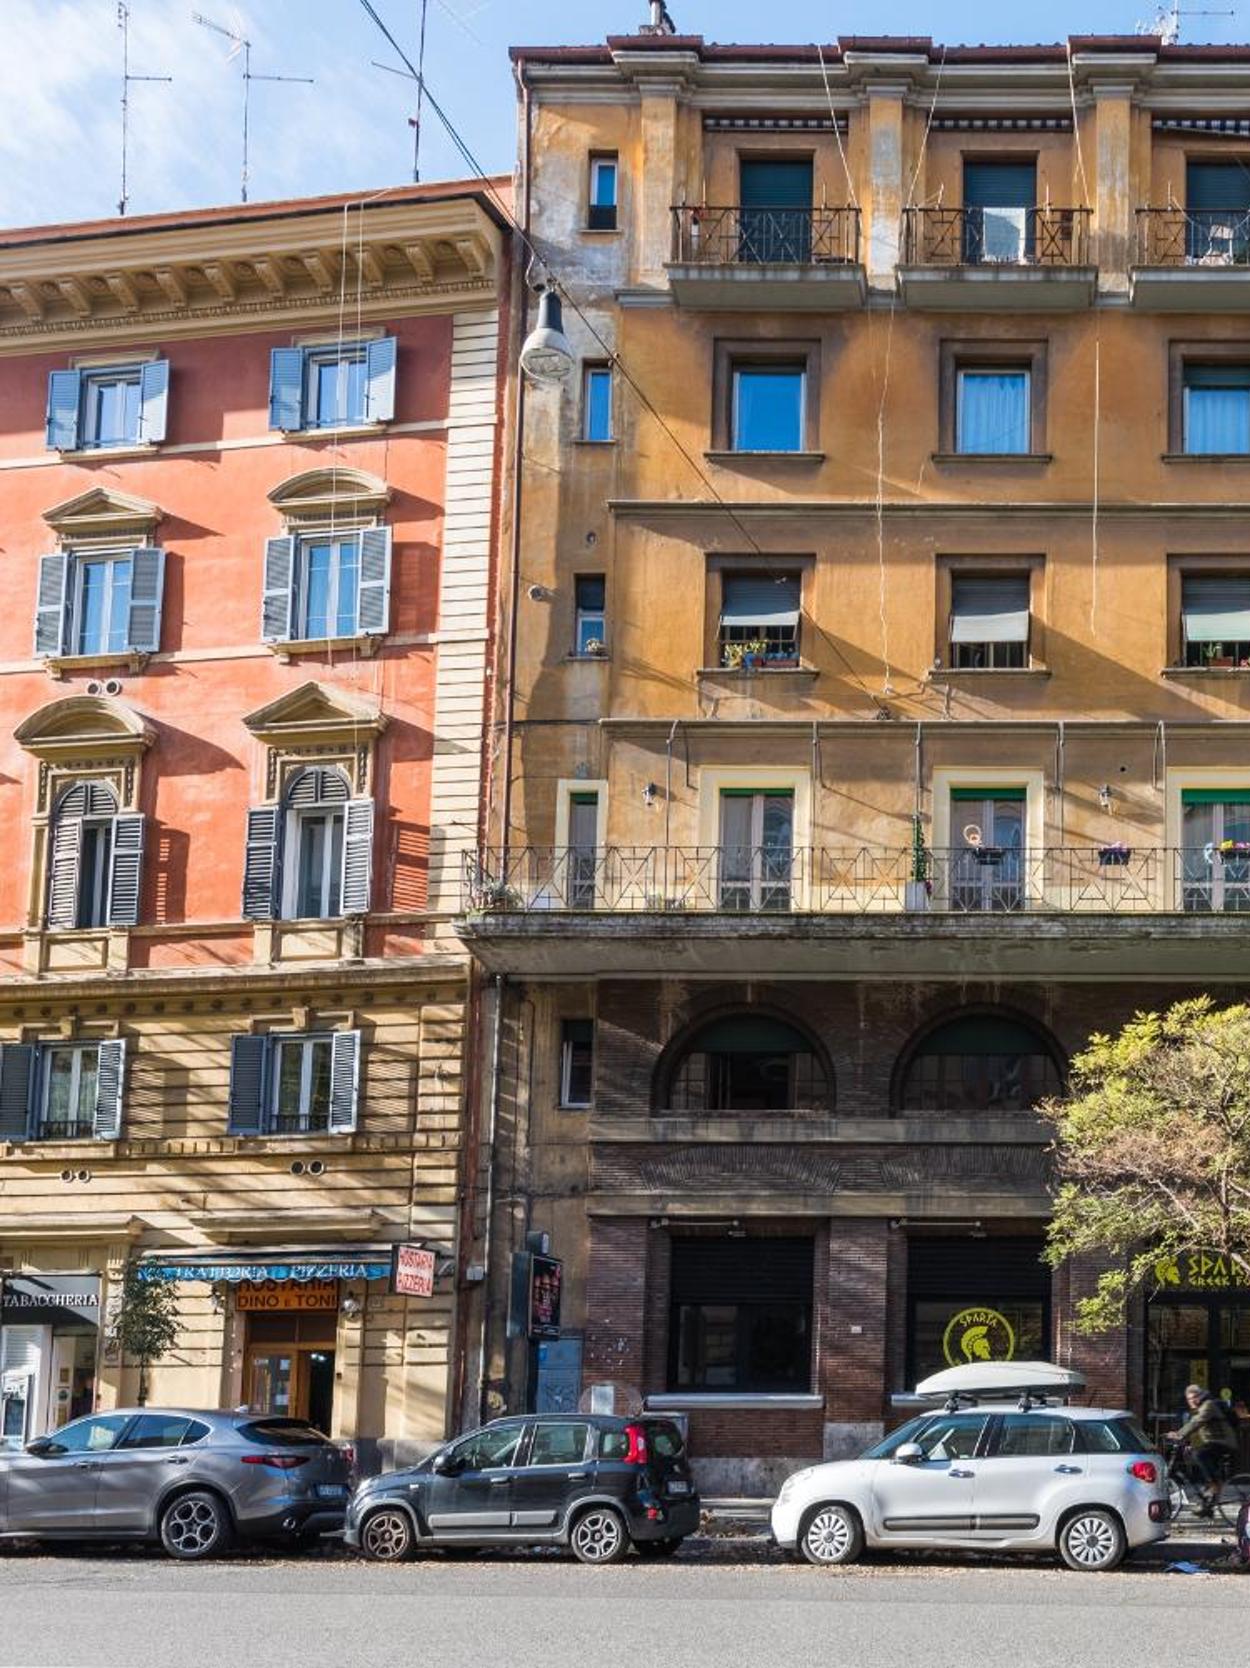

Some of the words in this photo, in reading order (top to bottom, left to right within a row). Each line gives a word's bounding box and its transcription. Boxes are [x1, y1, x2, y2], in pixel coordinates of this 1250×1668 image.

[176, 1265, 267, 1279] TRATTORIA
[290, 1264, 367, 1278] PIZZERIA
[1188, 1275, 1230, 1286] GREEK
[3, 1293, 99, 1307] TABACCHERIA
[238, 1295, 280, 1308] DINO
[295, 1294, 336, 1307] TONI
[959, 1312, 998, 1327] SPARTA
